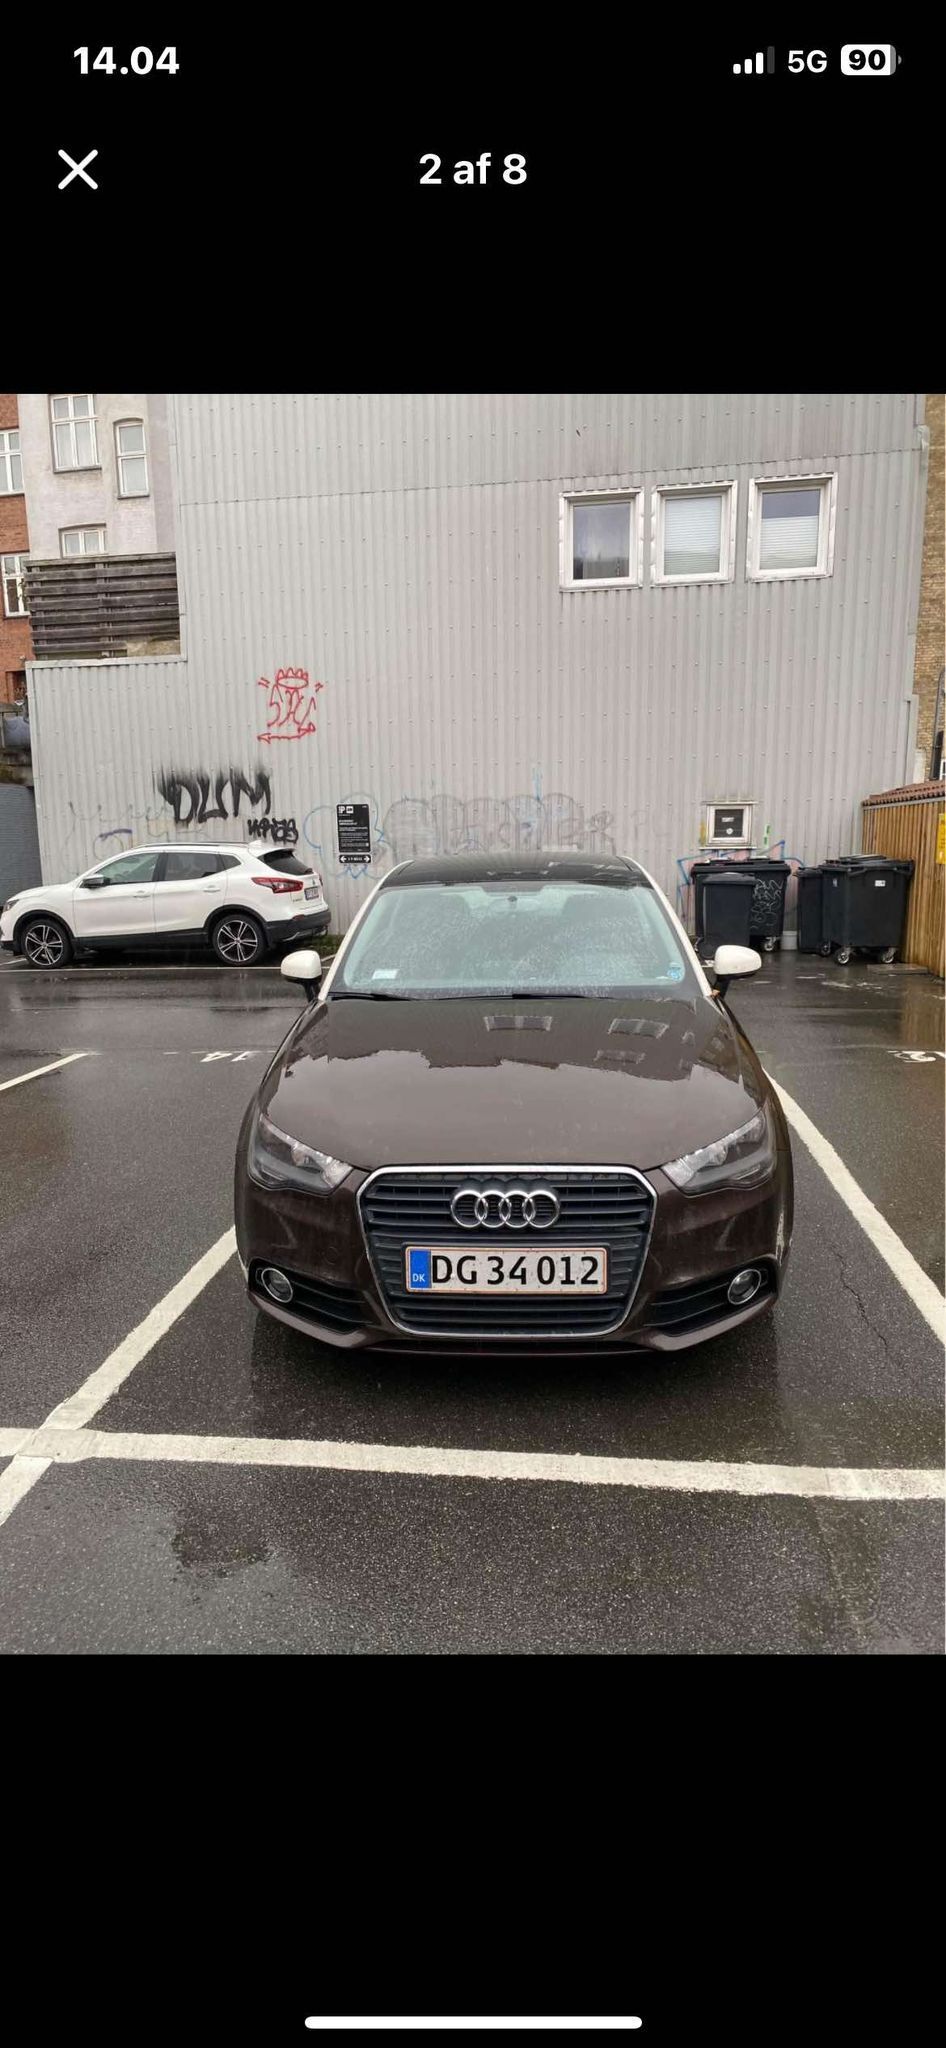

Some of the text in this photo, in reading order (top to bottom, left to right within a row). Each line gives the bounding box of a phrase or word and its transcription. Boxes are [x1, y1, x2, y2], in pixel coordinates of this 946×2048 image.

[412, 1273, 425, 1283] DK
[432, 1255, 599, 1285] DG 34 012
